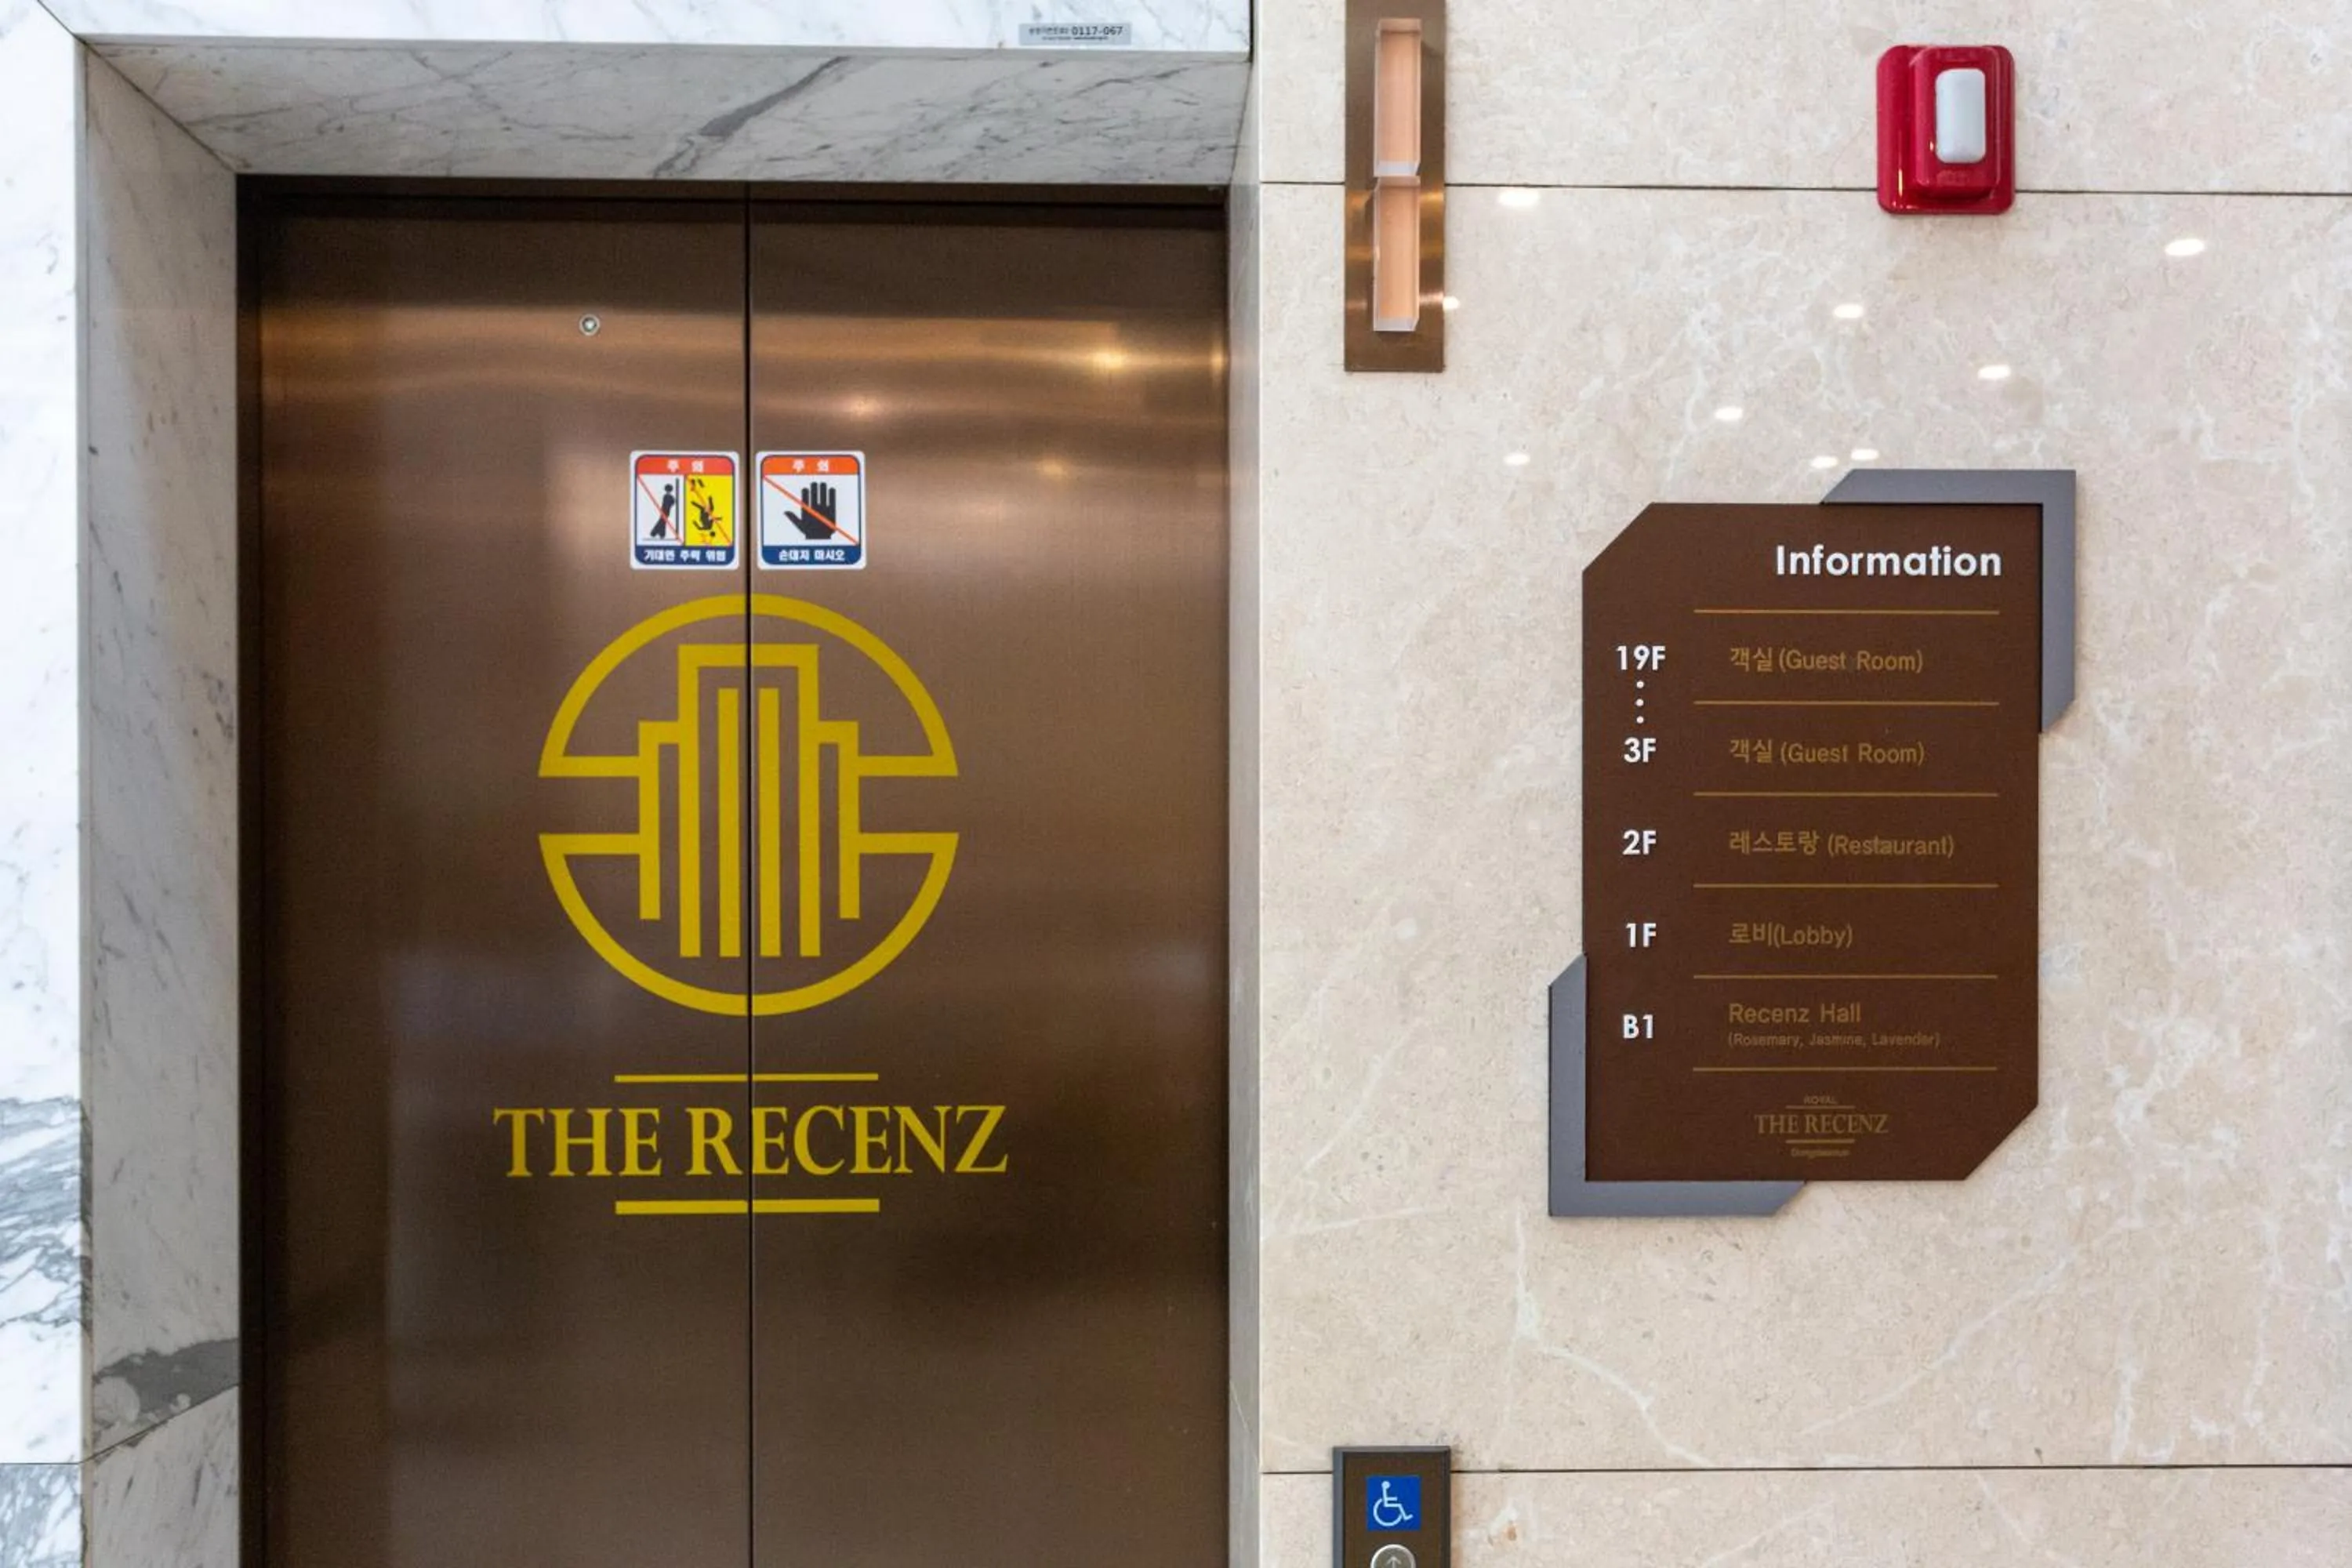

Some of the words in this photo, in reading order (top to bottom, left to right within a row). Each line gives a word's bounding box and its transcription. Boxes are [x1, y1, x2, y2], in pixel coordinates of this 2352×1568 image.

[779, 549, 810, 562] 손대지
[814, 549, 845, 562] 마시오
[1775, 544, 2002, 577] Information
[1615, 644, 1667, 672] 19F
[1730, 646, 1774, 673] 객실
[1778, 647, 1847, 673] (Guest
[1856, 649, 1924, 674] Room)
[1623, 737, 1657, 764] 3F
[1730, 739, 1773, 764] 객실
[1780, 741, 1849, 767] (Guest
[1857, 742, 1926, 767] Room)
[1622, 829, 1657, 855] 2F
[1729, 829, 1820, 856] 레스토랑
[1827, 833, 1955, 858] (Restaurant)
[1625, 922, 1657, 948] 1F
[1728, 922, 1853, 949] 로비(Lobby)
[1622, 1014, 1655, 1039] B1
[1729, 1003, 1809, 1024] Recenz
[1820, 1003, 1862, 1023] Hall
[1727, 1032, 1804, 1047] (Rosemary,
[1809, 1033, 1867, 1047] Jasmine,
[1871, 1032, 1940, 1047] Lavender)
[1754, 1113, 1800, 1134] THE
[1804, 1113, 1889, 1134] RECENZ
[493, 1107, 662, 1176] THE
[684, 1104, 1010, 1176] RECENZ
